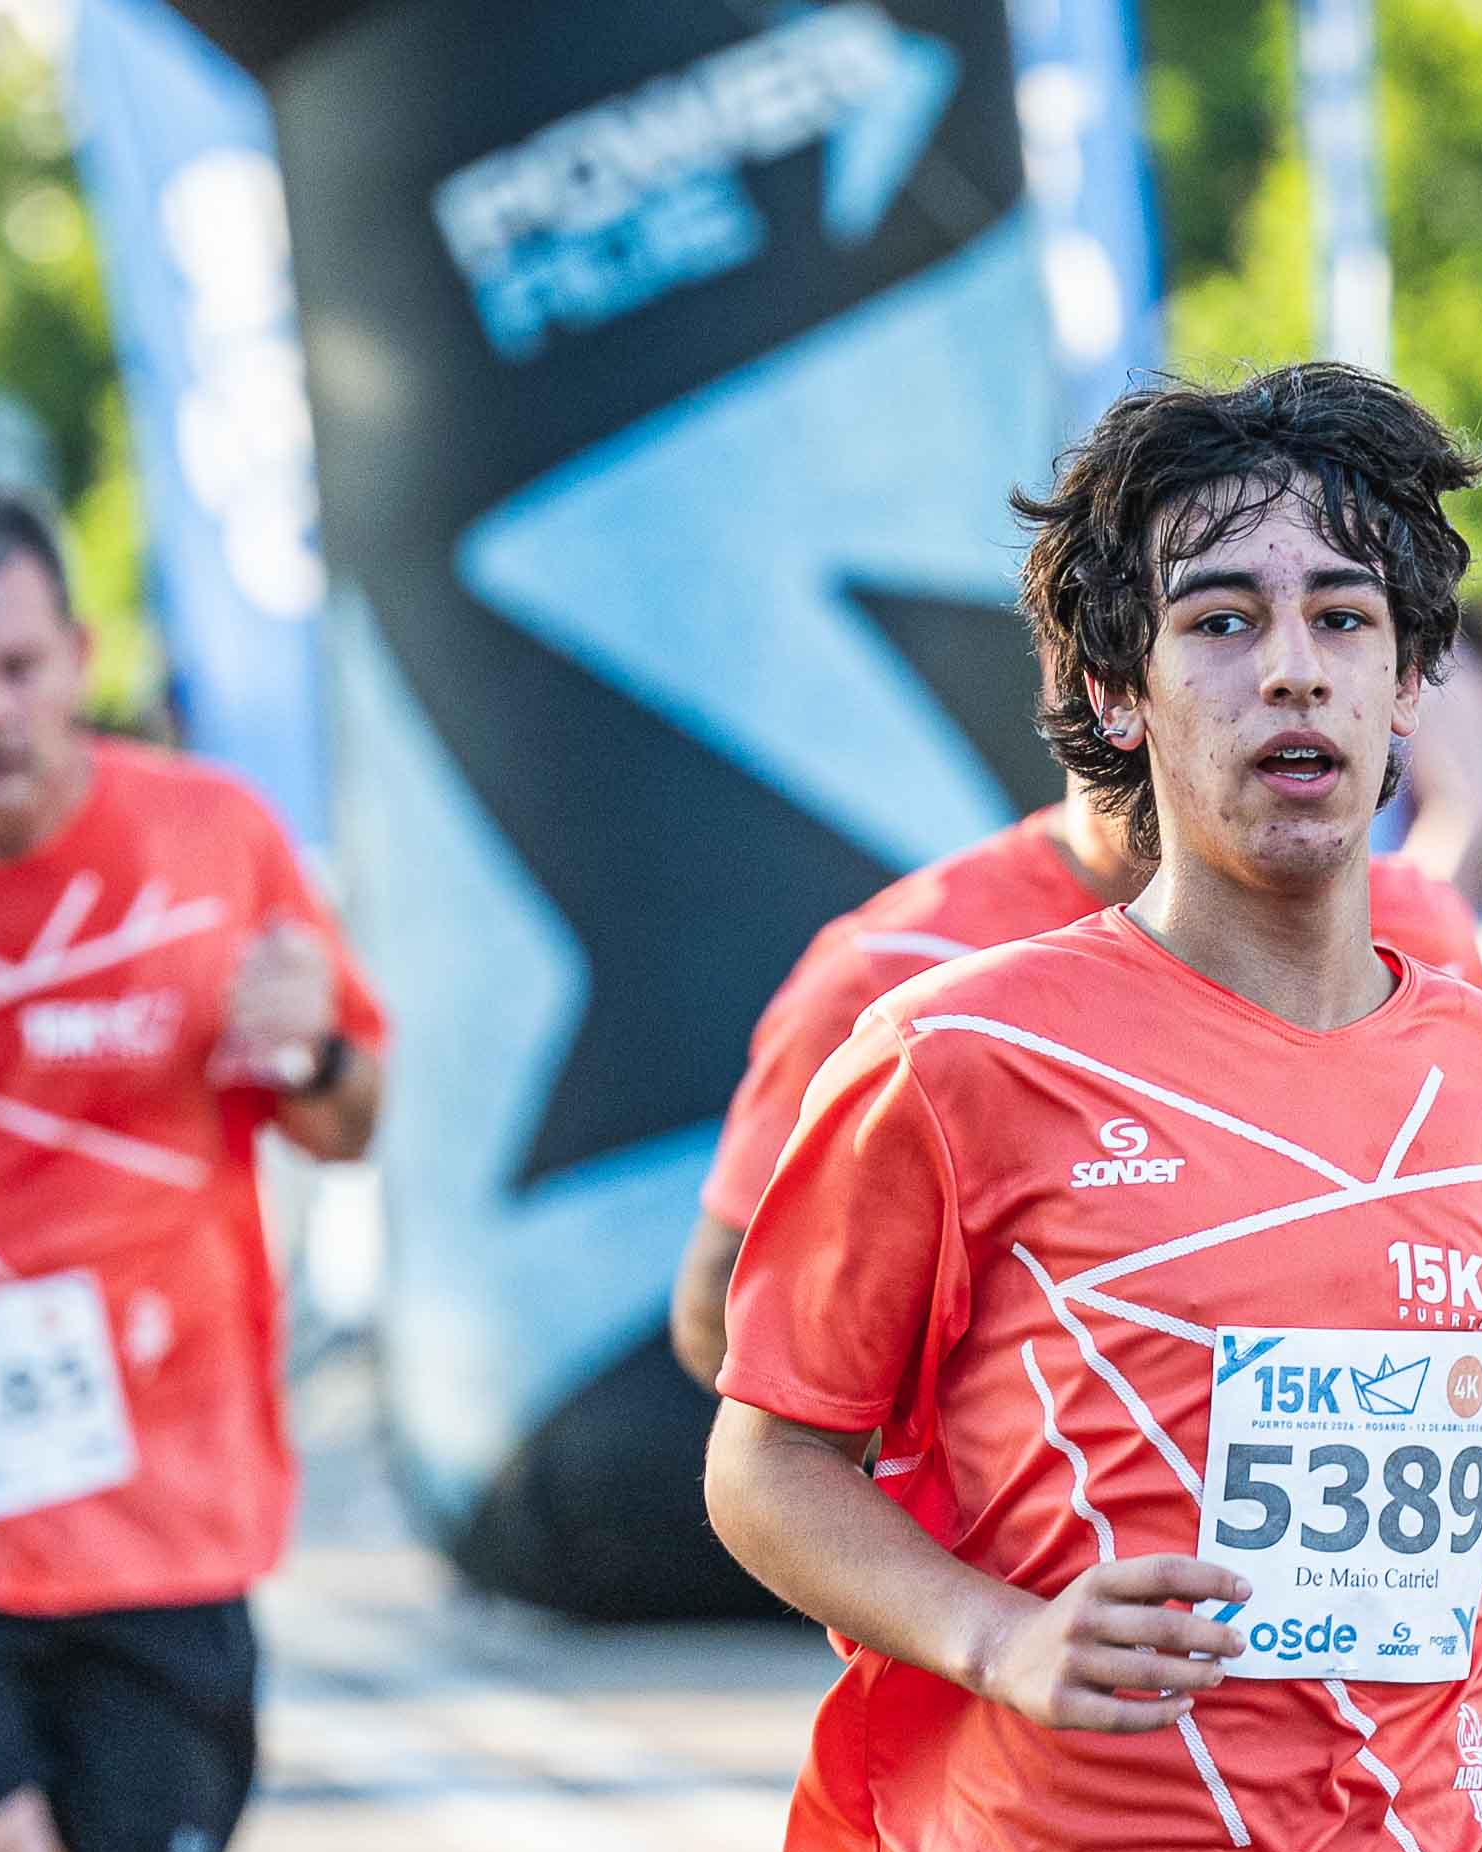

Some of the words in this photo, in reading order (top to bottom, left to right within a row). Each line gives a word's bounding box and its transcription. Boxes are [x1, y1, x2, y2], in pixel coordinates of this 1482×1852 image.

[1254, 1365, 1342, 1414] 15K
[1454, 1376, 1479, 1399] 4K
[1251, 1419, 1293, 1429] PUERTO
[1296, 1421, 1327, 1431] NORTE
[1365, 1422, 1406, 1432] ROSARIO
[1429, 1423, 1438, 1433] DE
[1295, 1566, 1323, 1587] De
[1329, 1568, 1378, 1588] Maio
[1384, 1567, 1439, 1589] Catriel
[1250, 1613, 1357, 1658] osde
